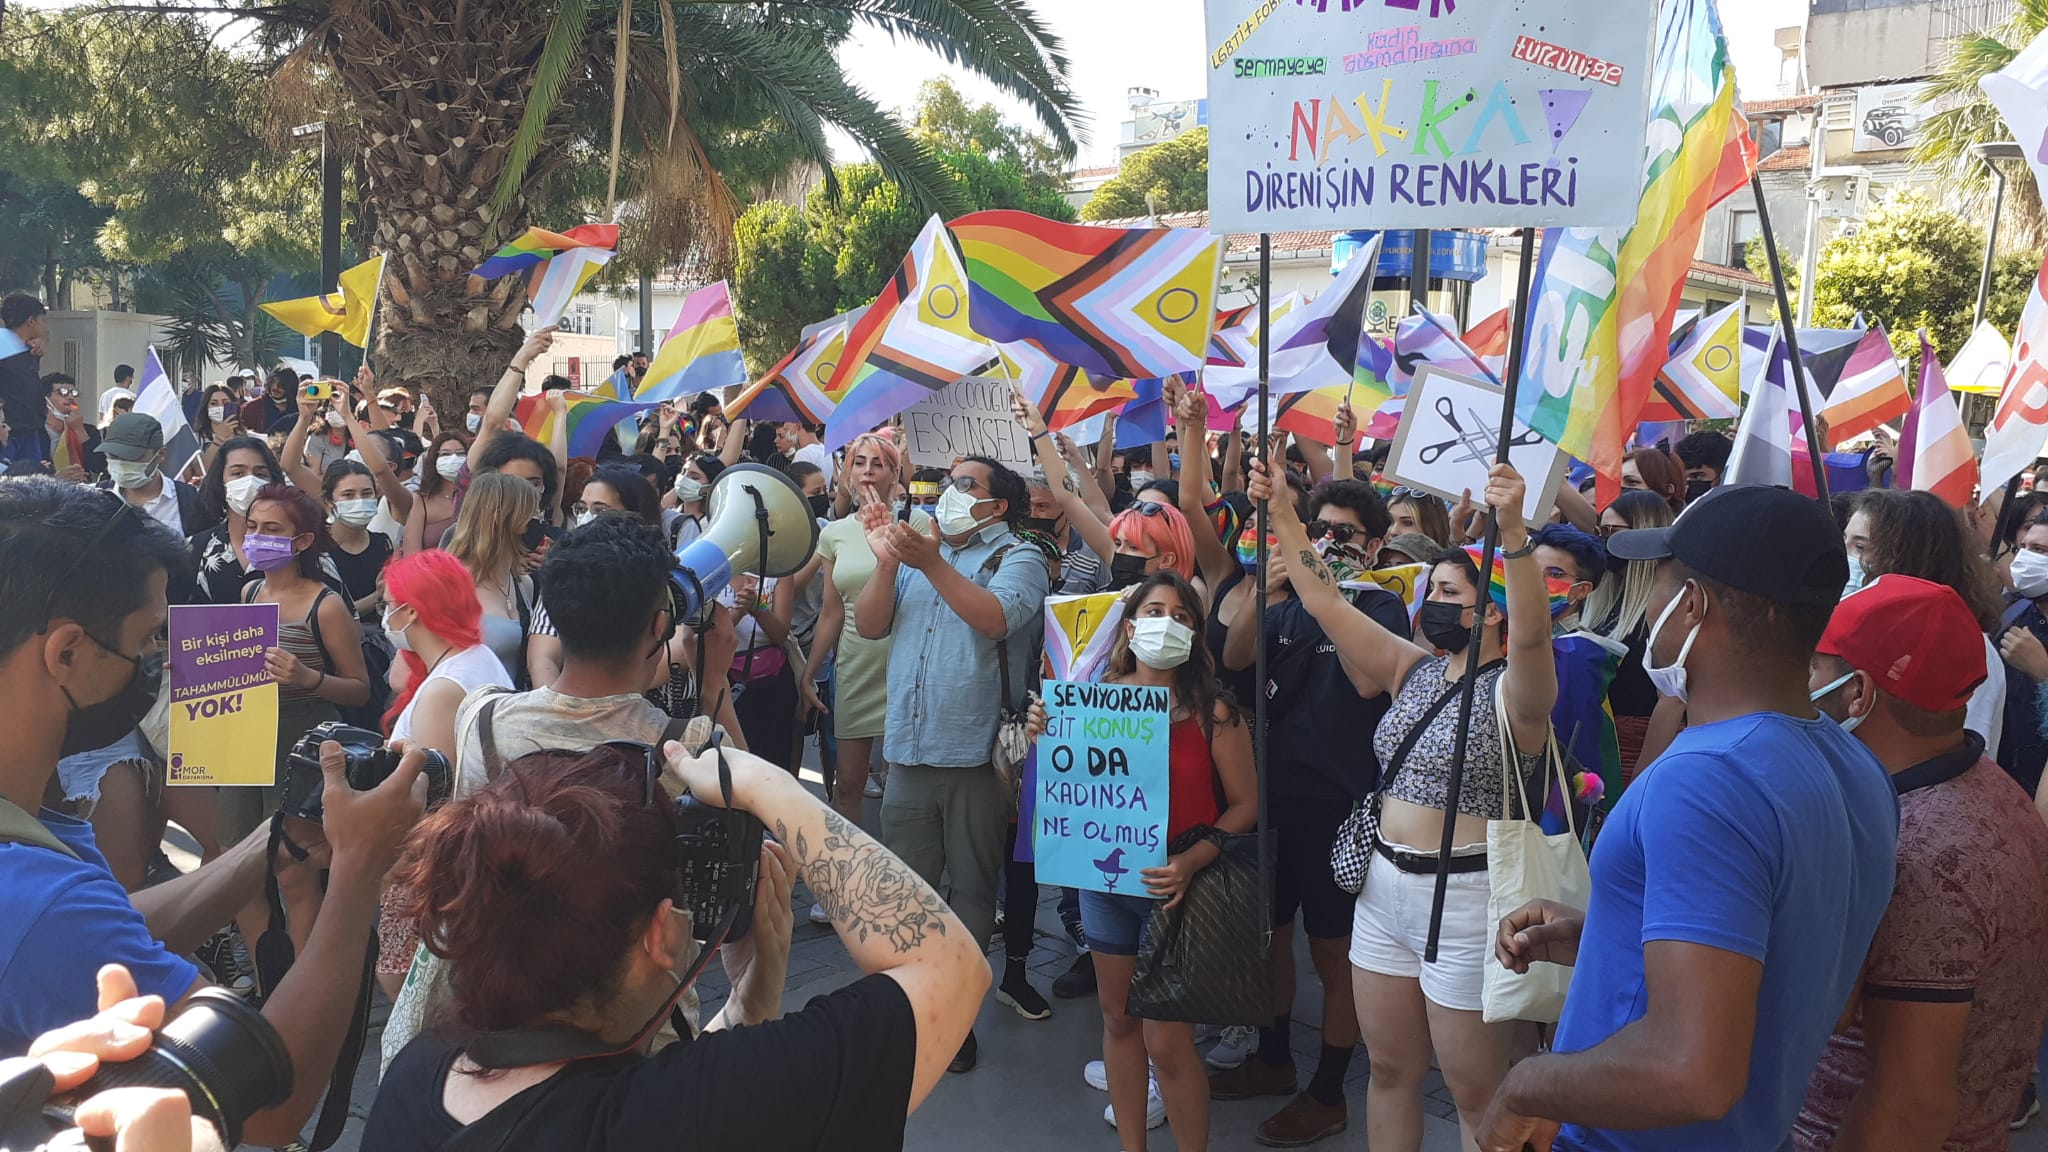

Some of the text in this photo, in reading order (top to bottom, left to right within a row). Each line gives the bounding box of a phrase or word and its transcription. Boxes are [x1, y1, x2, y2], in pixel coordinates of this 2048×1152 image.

[1247, 157, 1578, 213] DİRENİŞİN RENKLERİ
[955, 382, 1012, 415] ÇOCUĞU
[181, 625, 264, 652] Bir kişi daha
[196, 644, 263, 666] eksilmeye
[185, 693, 243, 721] YOK!
[1054, 682, 1168, 713] SEVİYORSAN
[1045, 709, 1155, 744] GİT KONUŞ
[183, 766, 205, 774] MOR
[1052, 745, 1129, 776] O DA
[1045, 780, 1147, 811] KADINSA
[1043, 816, 1072, 837] NE
